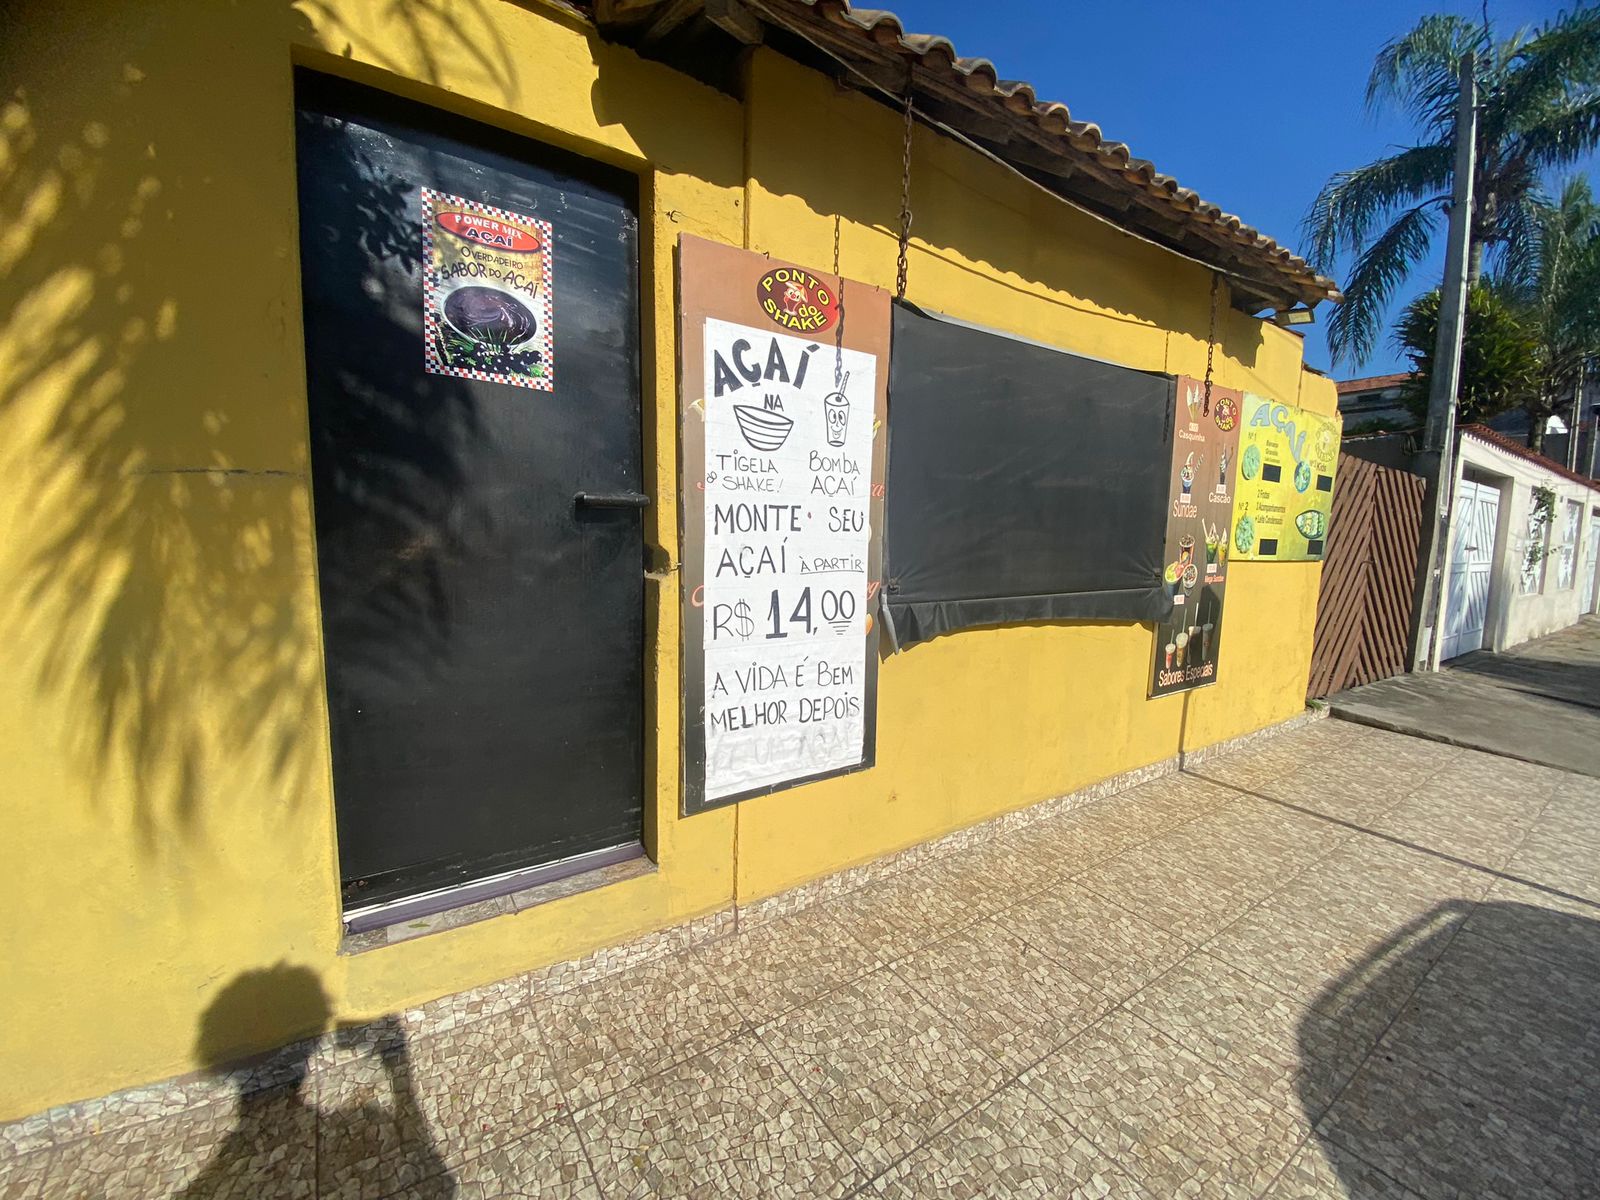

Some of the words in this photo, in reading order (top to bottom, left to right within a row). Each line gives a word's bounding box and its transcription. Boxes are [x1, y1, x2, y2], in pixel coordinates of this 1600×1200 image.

[454, 215, 500, 232] POWER
[501, 225, 524, 240] MIX
[466, 227, 513, 248] AÇAÍ
[470, 250, 524, 270] VERDADEIRO
[441, 261, 488, 280] SABOR
[489, 268, 502, 279] DO
[502, 270, 539, 299] AÇAÍ
[762, 269, 830, 306] PONTO
[763, 298, 827, 331] SHAKE
[714, 336, 820, 397] AÇAÍ
[763, 393, 785, 412] NA
[1179, 429, 1206, 443] Casquinha
[716, 450, 779, 474] TIGELA
[722, 475, 784, 493] SHAKE!
[811, 475, 858, 497] AÇAÍ
[714, 503, 802, 535] MONTE
[828, 506, 864, 532] SEU
[1172, 500, 1198, 519] Sundae
[715, 536, 788, 579] AÇAÍ
[813, 554, 863, 571] PARTIR
[713, 598, 755, 641] R$
[765, 586, 856, 639] 14,00
[711, 672, 729, 698] A
[734, 661, 788, 694] VIDA
[795, 656, 809, 687] É
[817, 660, 854, 686] BEM
[1158, 669, 1185, 687] Sabores
[1185, 660, 1214, 682] Especiais
[711, 699, 788, 731] MELHOR
[799, 692, 860, 723] DEPOIS
